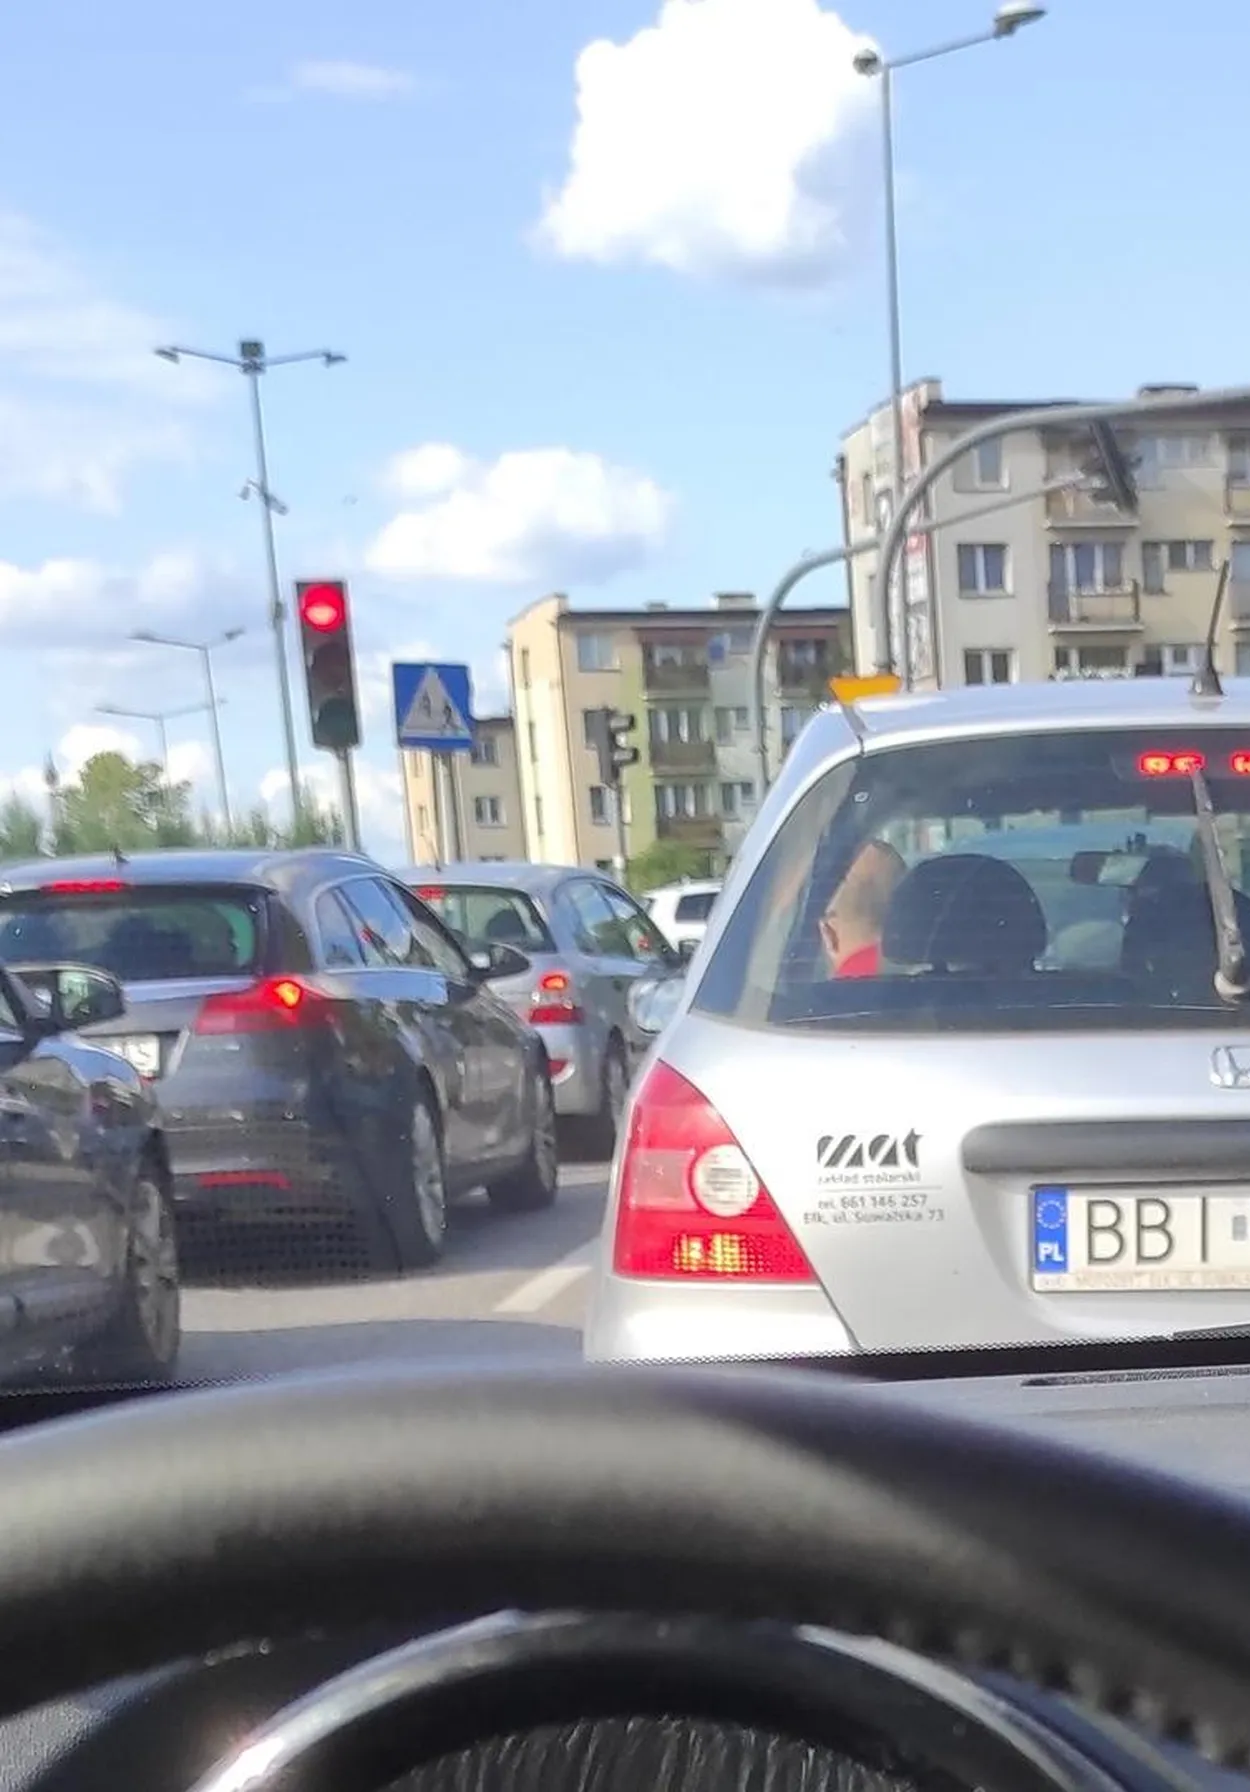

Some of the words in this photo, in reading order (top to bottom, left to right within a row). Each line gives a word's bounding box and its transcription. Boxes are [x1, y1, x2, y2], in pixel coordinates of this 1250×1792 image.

[901, 1194, 928, 1208] 257
[1086, 1196, 1209, 1265] BBI
[1038, 1242, 1065, 1263] PL
